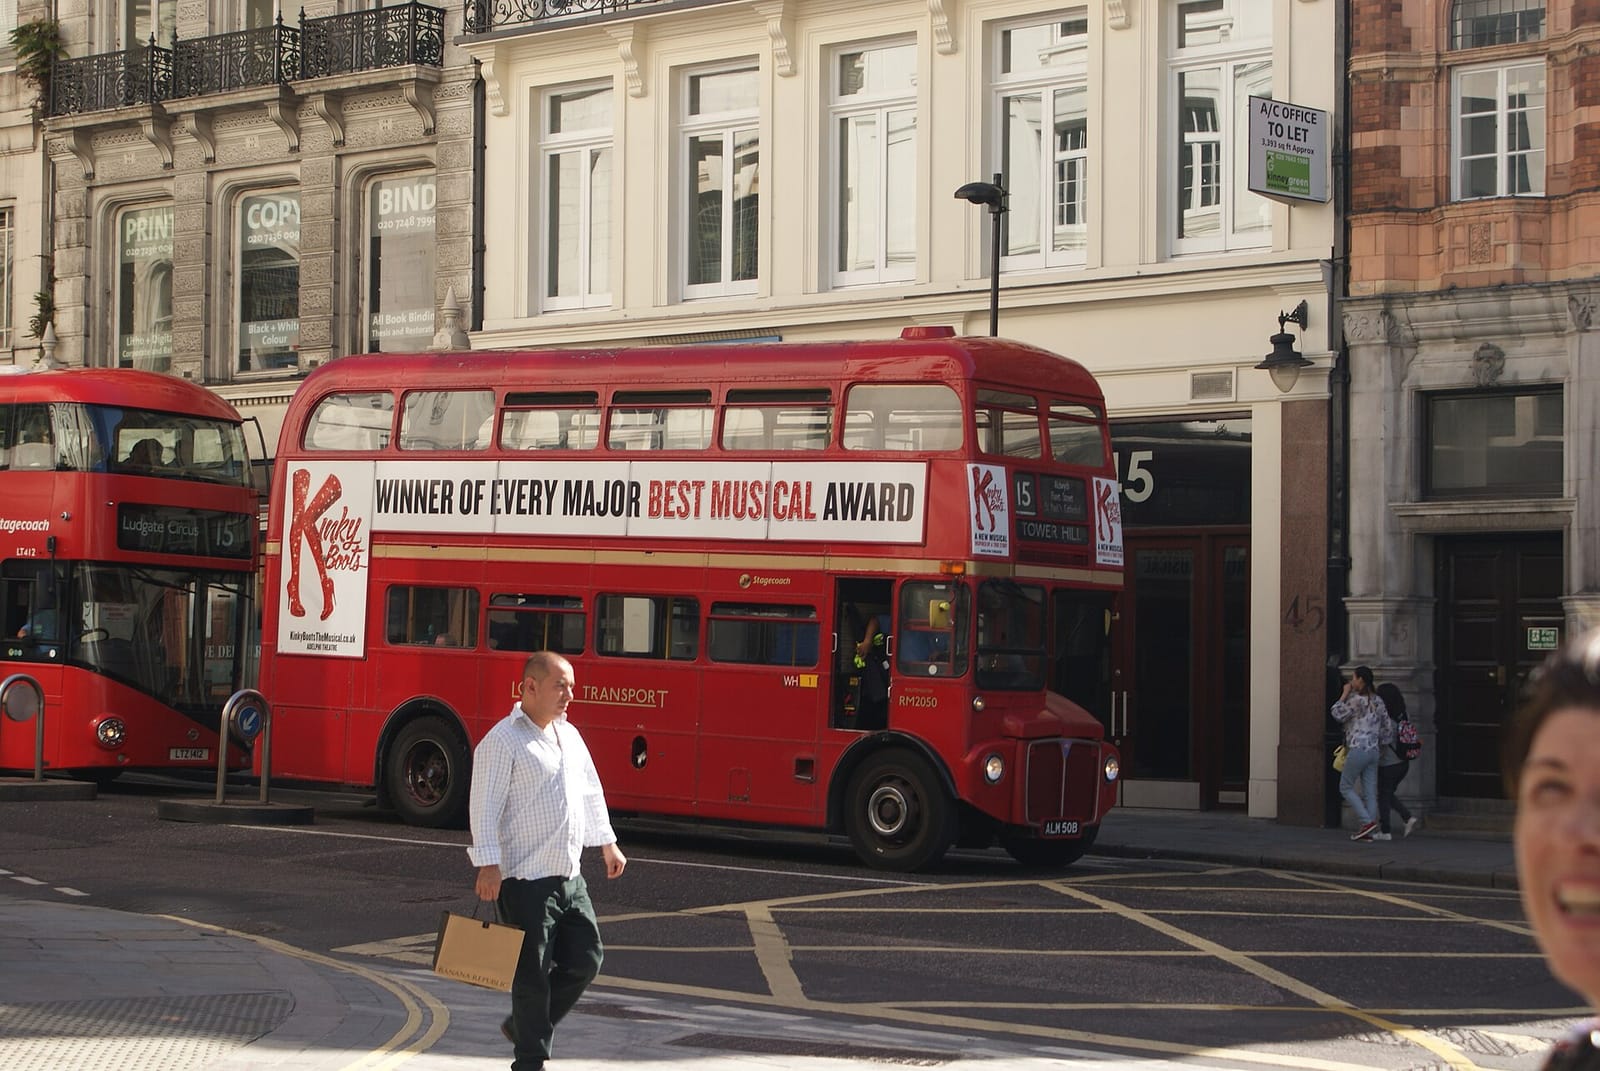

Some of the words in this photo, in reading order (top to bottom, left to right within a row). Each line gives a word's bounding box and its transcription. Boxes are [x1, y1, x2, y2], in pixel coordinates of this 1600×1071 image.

[1260, 102, 1279, 118] A/C
[1282, 106, 1317, 125] OFFICE
[1268, 121, 1284, 138] TO
[1287, 125, 1309, 143] LET
[1286, 143, 1291, 151] ft
[1292, 143, 1315, 155] Approx
[379, 183, 436, 215] BIND
[377, 220, 393, 229] 020
[247, 233, 262, 243] 020
[372, 314, 383, 325] All
[385, 312, 406, 325] Book
[408, 310, 435, 323] Bindin
[248, 322, 269, 334] Black
[262, 334, 288, 345] Colour
[375, 478, 453, 515] WINNER
[459, 478, 485, 516] OF
[490, 478, 558, 516] EVERY
[562, 479, 641, 518] MAJOR
[648, 480, 706, 520] BEST
[710, 480, 816, 522] MUSICAL
[823, 481, 915, 522] AWARD
[1017, 480, 1031, 507] 15
[0, 518, 50, 534] tagecoach
[123, 515, 164, 536] Ludgate
[168, 520, 200, 537] Circus
[216, 520, 234, 547] 15
[1023, 521, 1058, 539] TOWER
[1061, 525, 1081, 541] HILL
[16, 547, 36, 557] LT412
[324, 542, 368, 572] Boots
[753, 575, 791, 586] Stagecoach
[289, 631, 356, 643] KinkyBootsTheMusical.co.uk
[783, 674, 798, 687] WH
[582, 685, 669, 708] TRANSPORT
[899, 695, 938, 708] RM2050
[438, 967, 470, 978] BANANA
[472, 975, 507, 987] REPUBLIC
